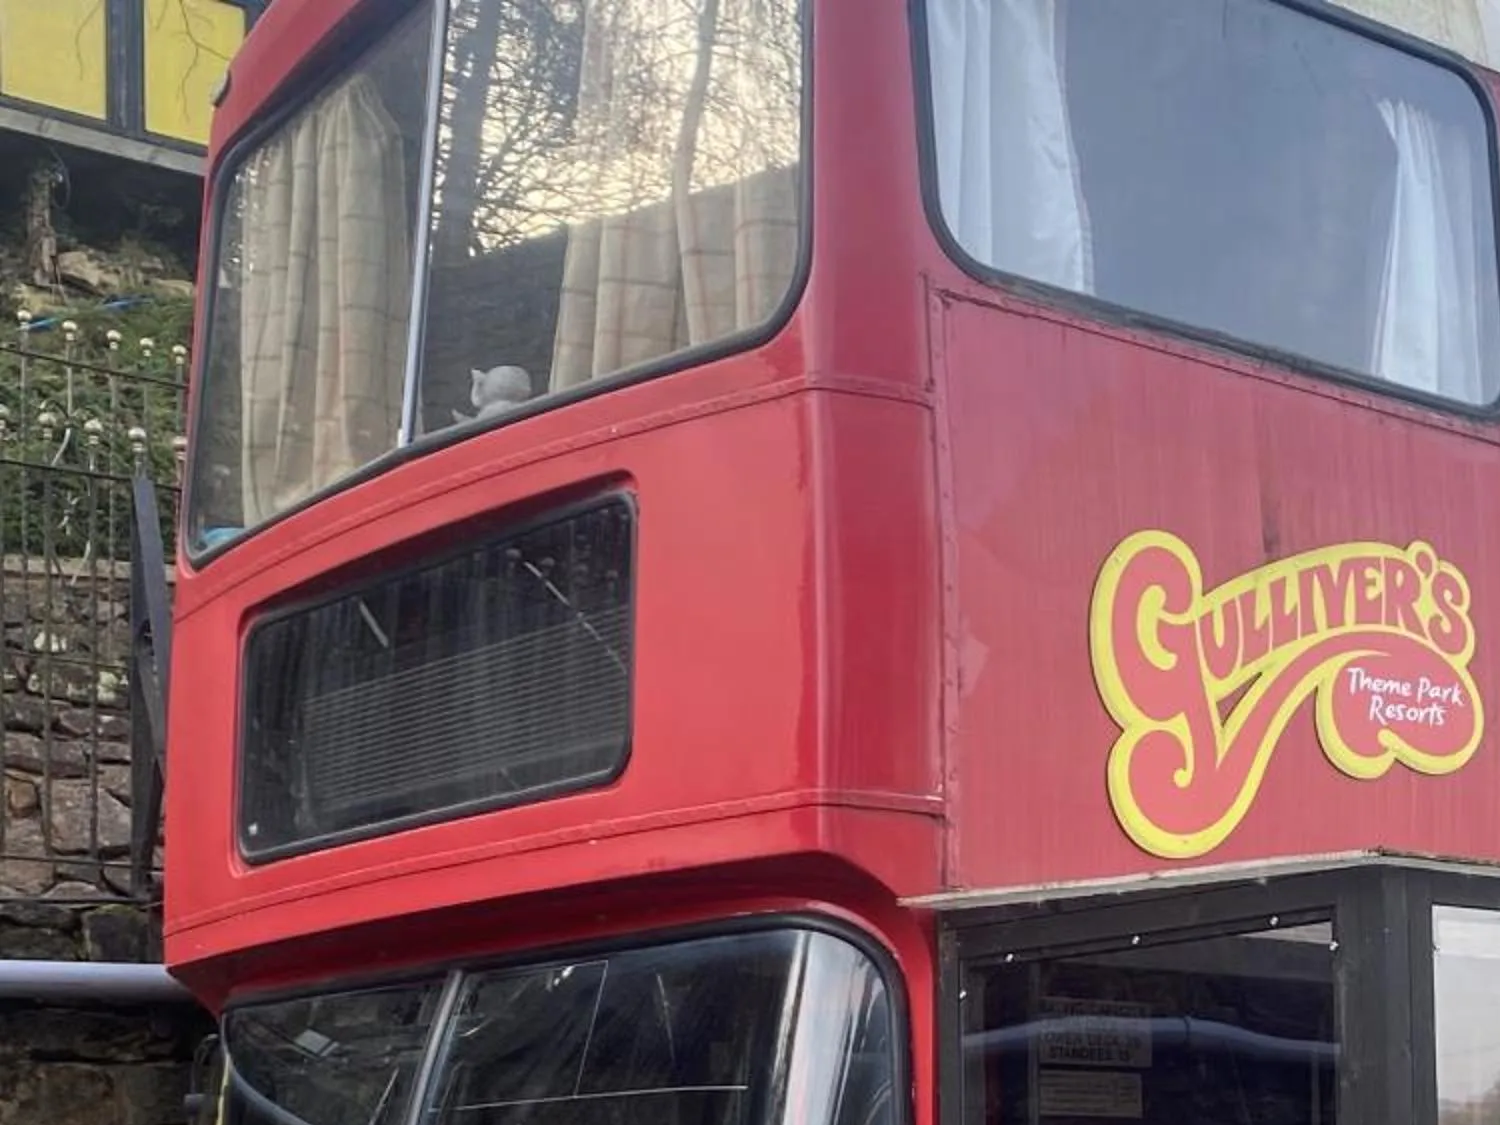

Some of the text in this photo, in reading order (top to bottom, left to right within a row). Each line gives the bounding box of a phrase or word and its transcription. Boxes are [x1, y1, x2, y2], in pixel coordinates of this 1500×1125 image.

[1100, 538, 1475, 845] GULLIVER'S
[1347, 666, 1465, 707] Theme Park
[1368, 694, 1447, 728] Resorts
